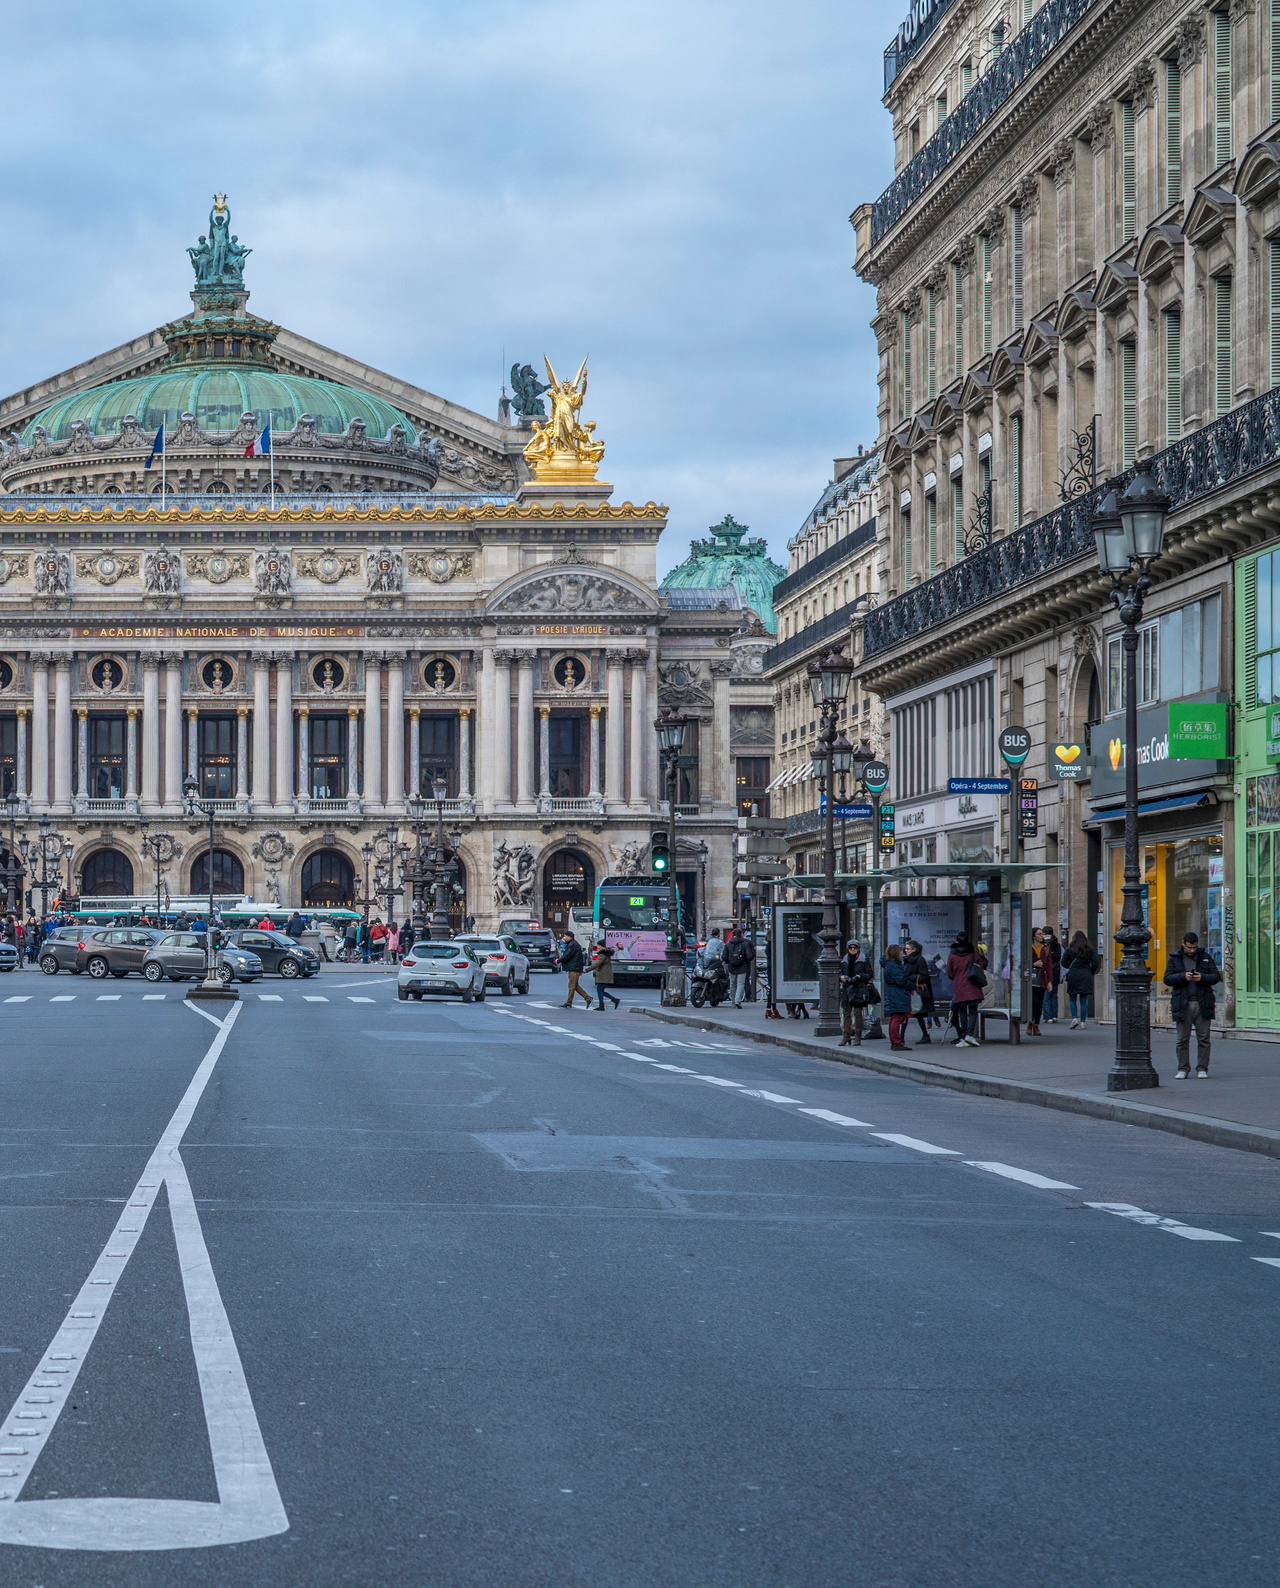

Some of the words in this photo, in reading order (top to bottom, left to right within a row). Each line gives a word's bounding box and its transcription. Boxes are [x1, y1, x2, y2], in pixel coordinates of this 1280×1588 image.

[100, 628, 164, 637] ACADEMIE
[176, 628, 238, 636] NATIONALE
[250, 628, 266, 636] DE
[277, 627, 336, 636] MUSIQUE
[572, 626, 603, 634] LYRIQUE
[1004, 735, 1027, 747] BUS
[1172, 733, 1222, 741] HERBORIST
[866, 768, 886, 779] BUS
[950, 782, 968, 790] Opéra
[978, 782, 1008, 790] Septembre
[1024, 780, 1035, 789] 27
[1022, 819, 1035, 828] 95
